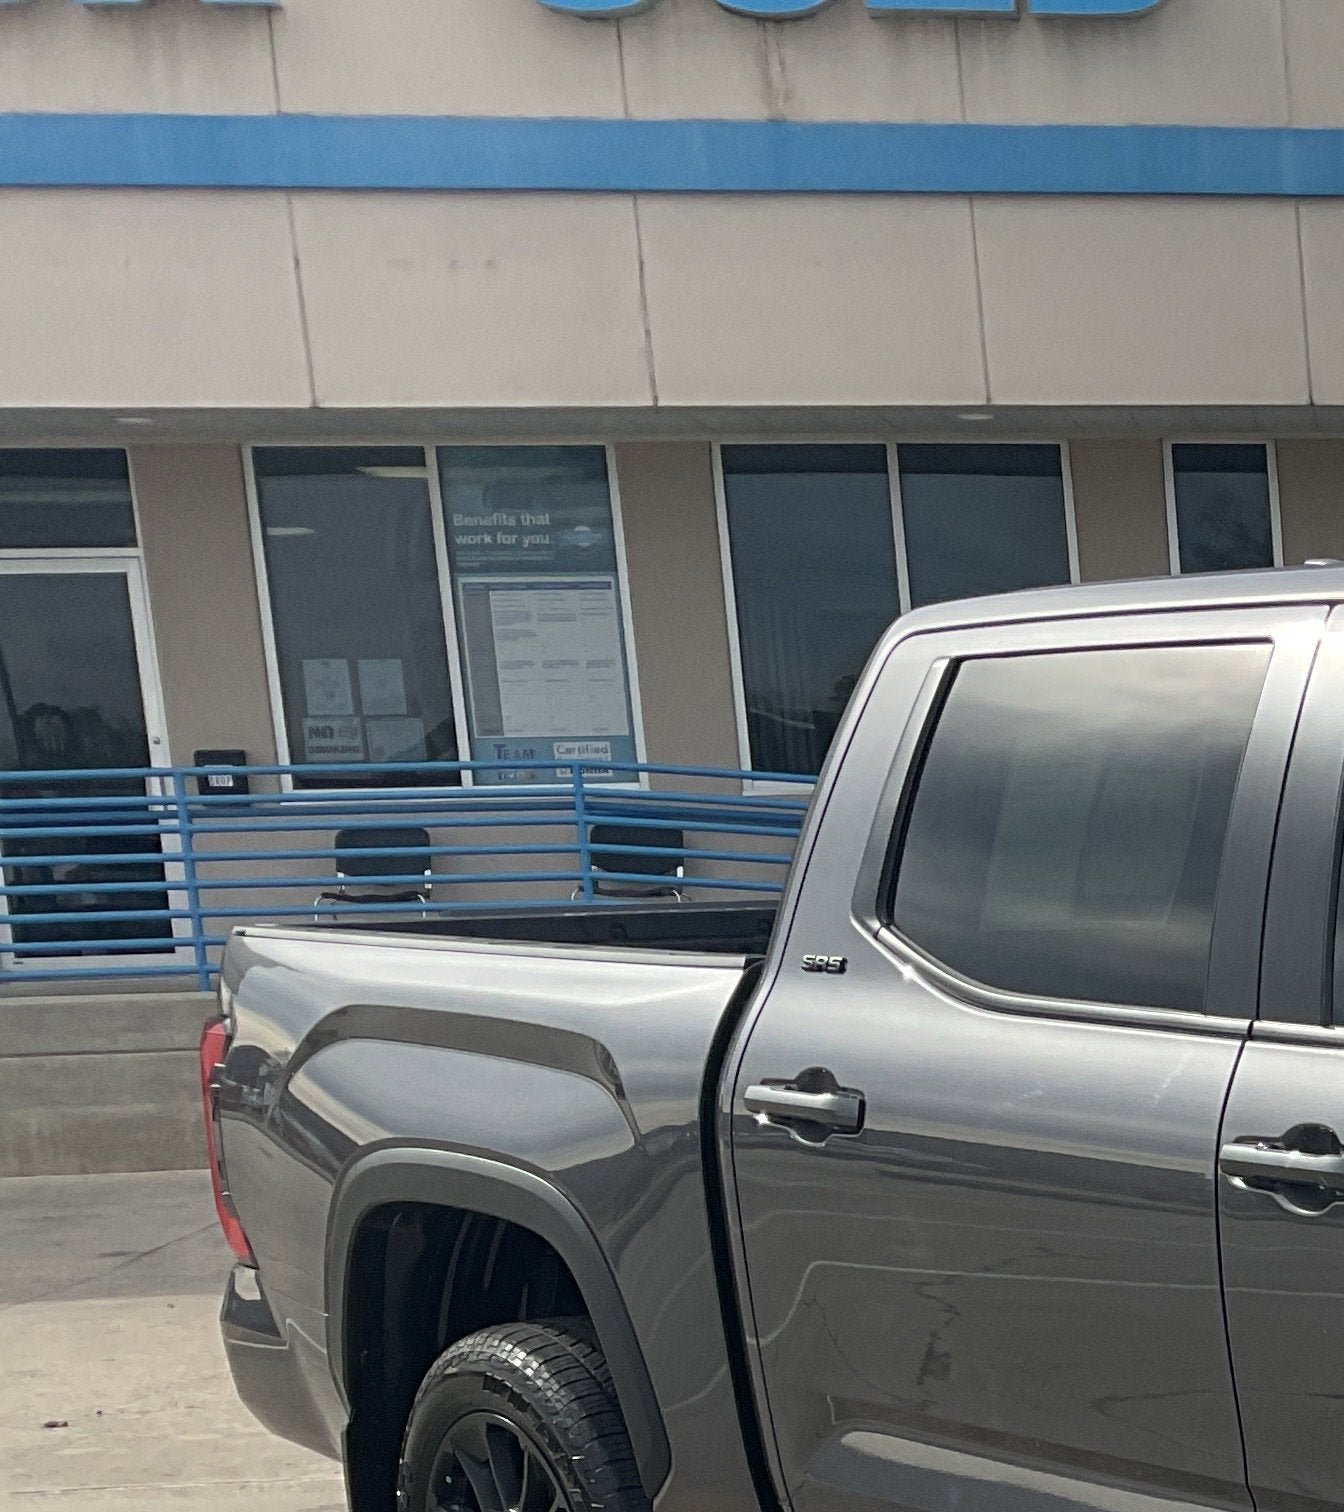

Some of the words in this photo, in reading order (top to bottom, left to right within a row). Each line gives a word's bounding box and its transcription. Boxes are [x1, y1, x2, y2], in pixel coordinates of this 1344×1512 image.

[453, 512, 516, 526] Benefits
[519, 513, 550, 526] that
[454, 532, 491, 545] work
[497, 532, 518, 545] for
[308, 725, 334, 739] NO
[556, 744, 608, 755] Certified
[801, 954, 846, 974] SR5
